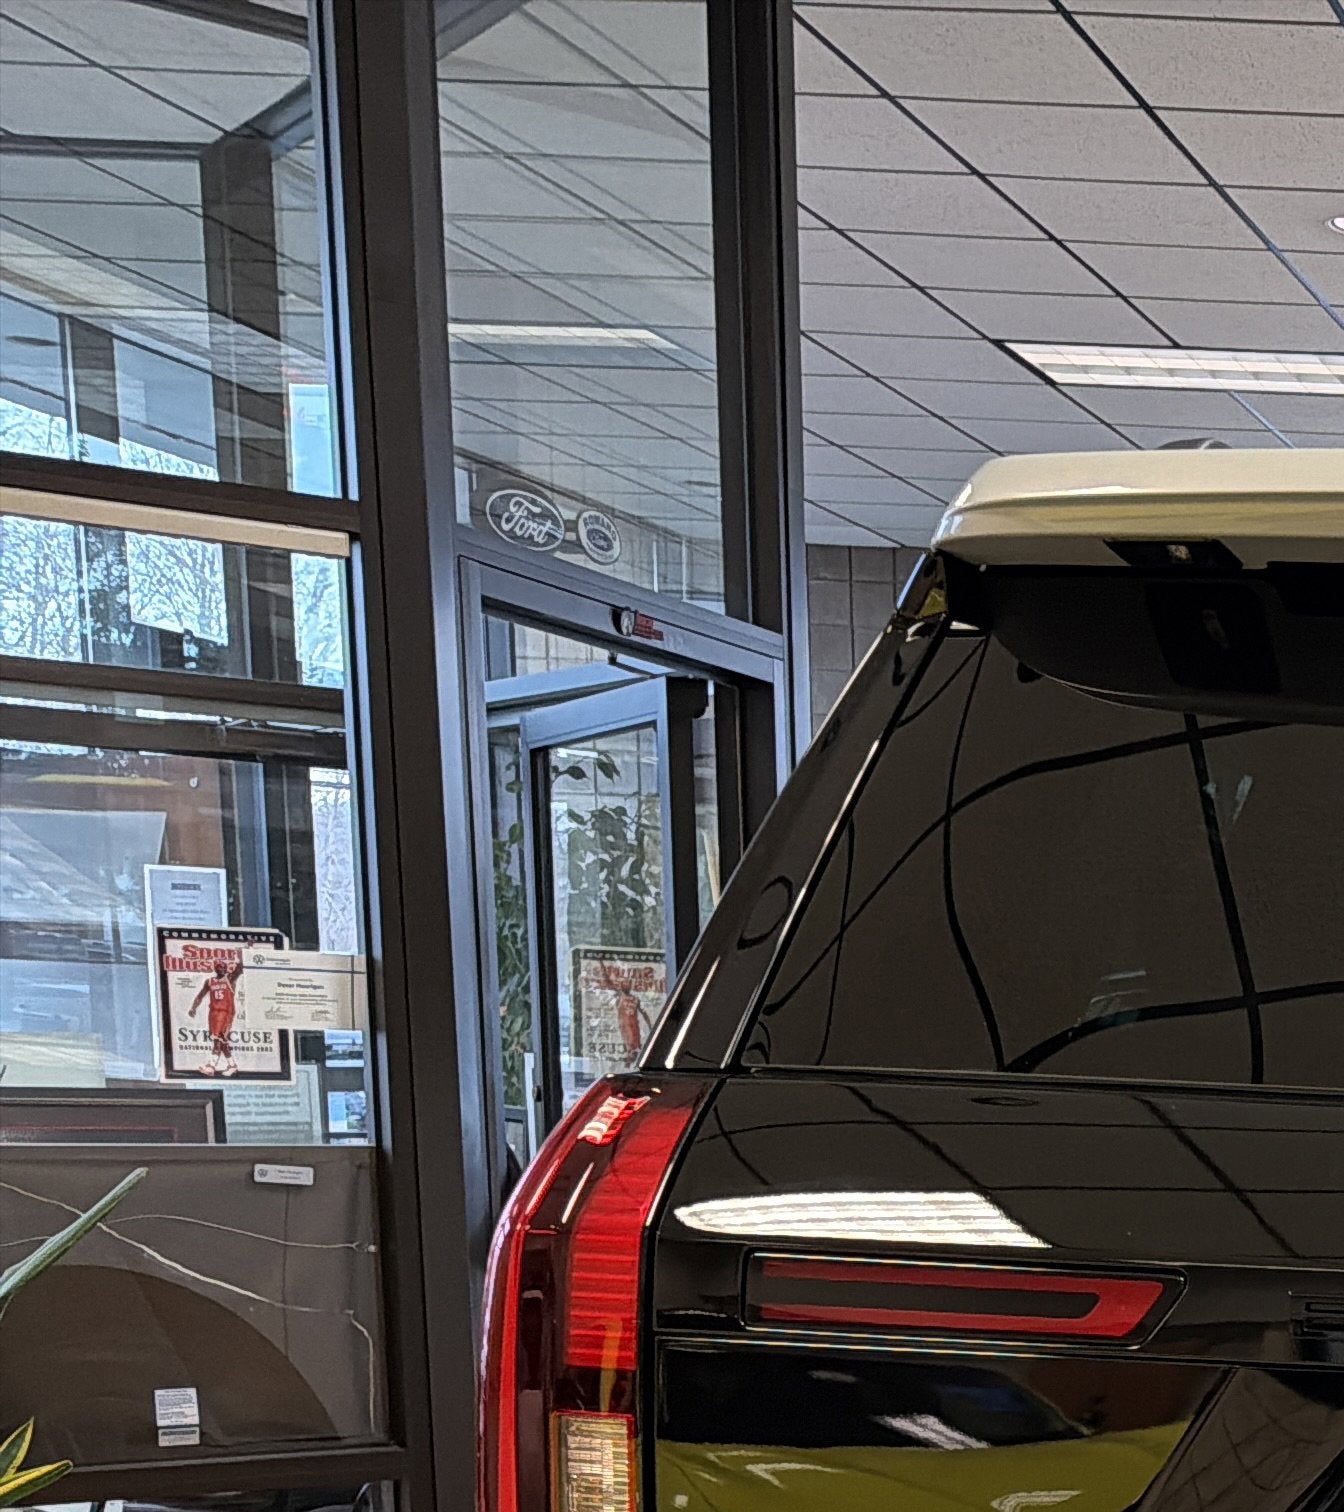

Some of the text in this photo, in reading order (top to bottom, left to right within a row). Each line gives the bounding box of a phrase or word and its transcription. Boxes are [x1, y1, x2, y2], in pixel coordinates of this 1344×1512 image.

[501, 496, 553, 544] Ford
[182, 944, 240, 960] Spor
[178, 1027, 274, 1045] SYRCUSE
